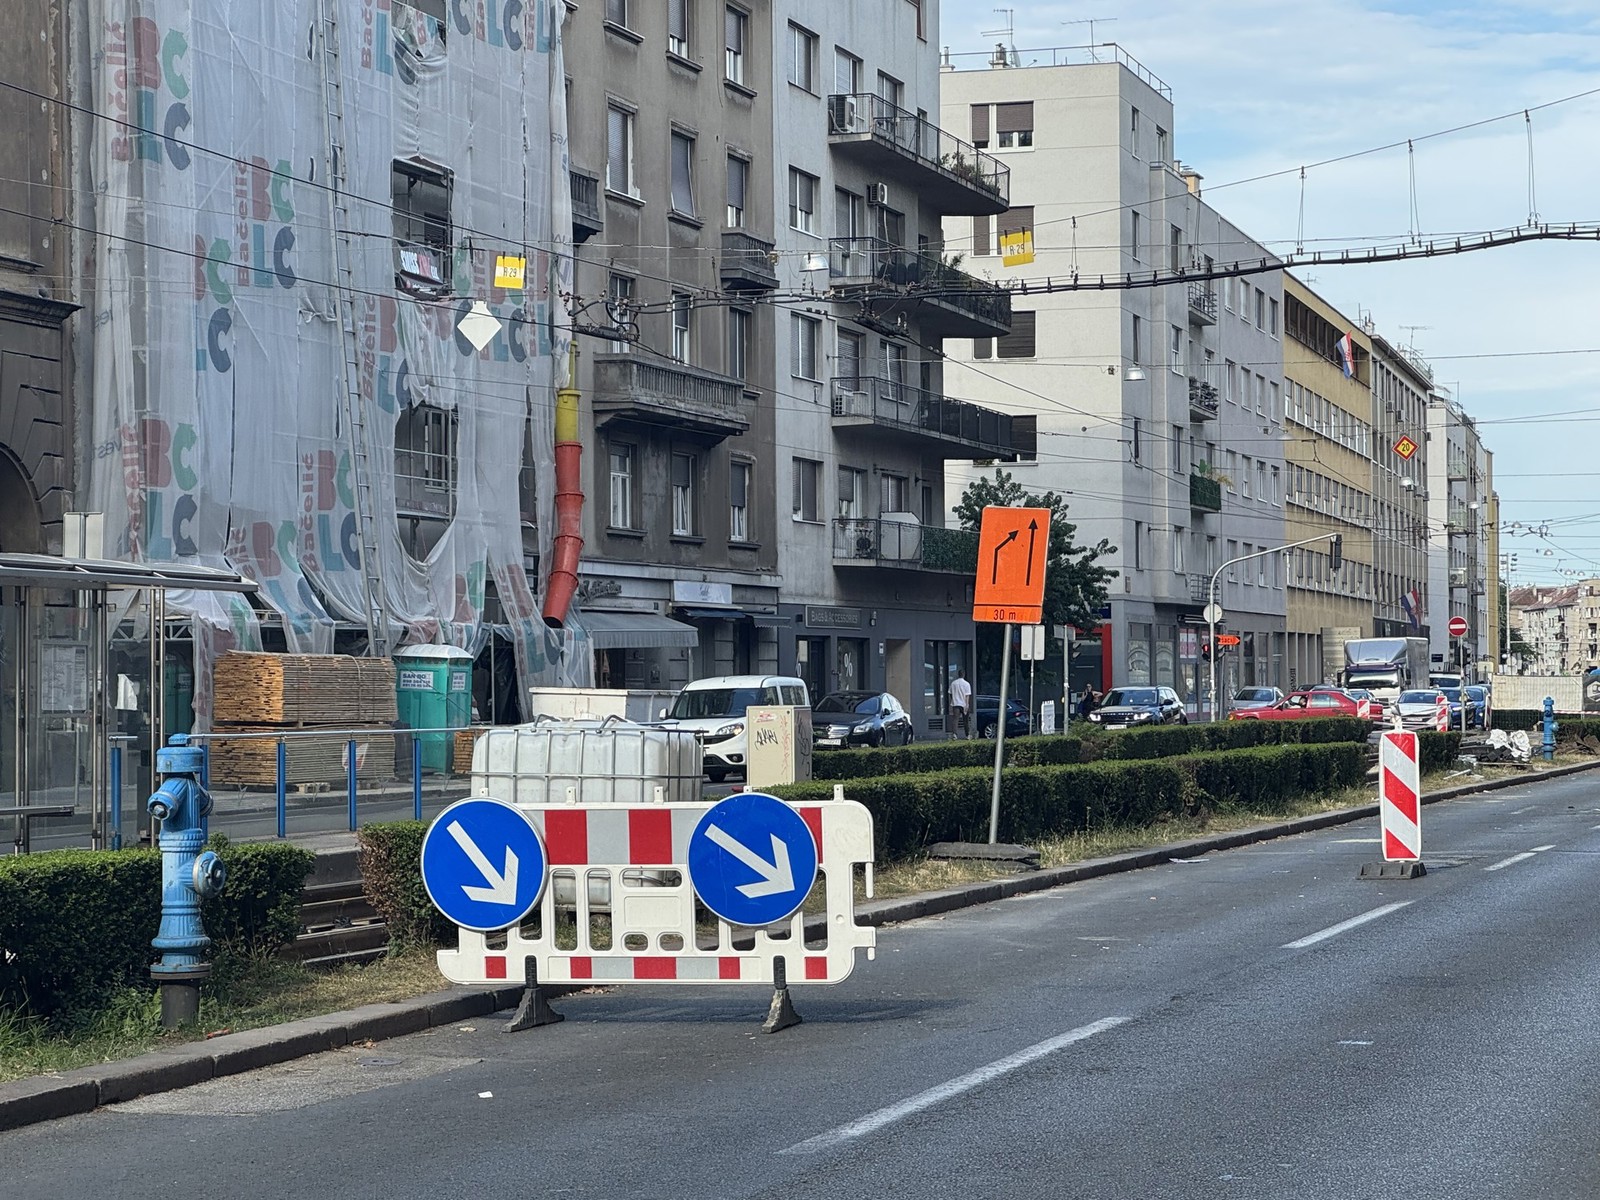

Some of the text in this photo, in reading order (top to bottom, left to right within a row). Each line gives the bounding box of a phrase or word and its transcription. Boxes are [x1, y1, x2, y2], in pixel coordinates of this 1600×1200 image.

[1401, 443, 1410, 451] 20
[993, 609, 1016, 621] 30 m
